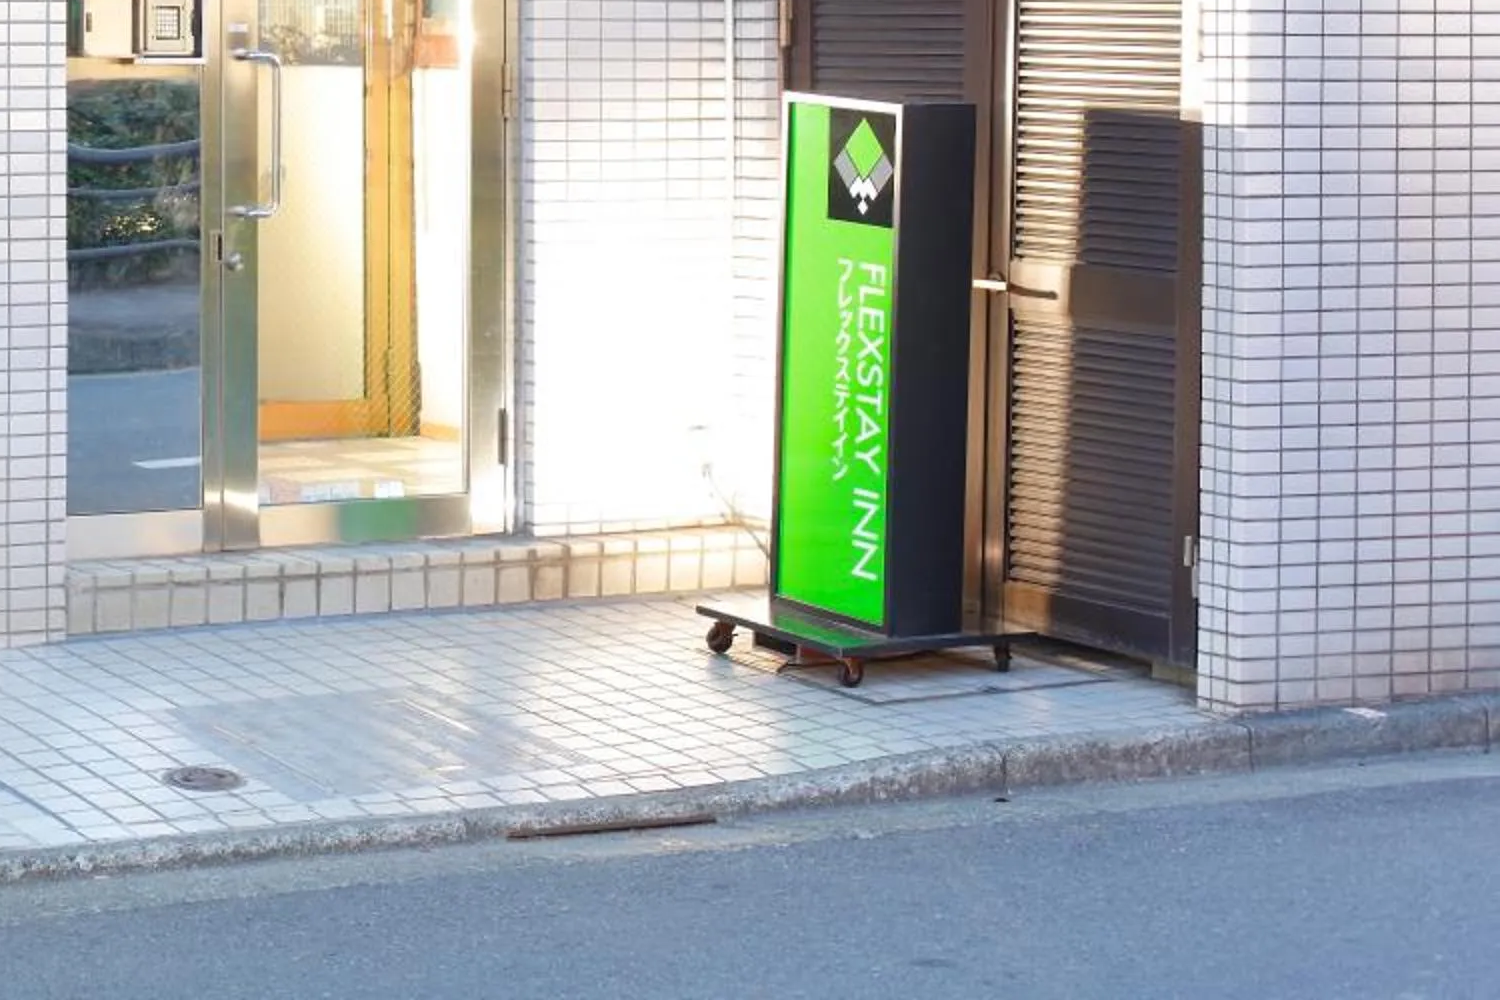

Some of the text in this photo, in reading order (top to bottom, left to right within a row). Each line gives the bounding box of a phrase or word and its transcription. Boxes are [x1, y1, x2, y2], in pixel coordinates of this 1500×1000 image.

[832, 257, 854, 481] フレックステイイン
[851, 261, 887, 581] FLEXSTAY INN
